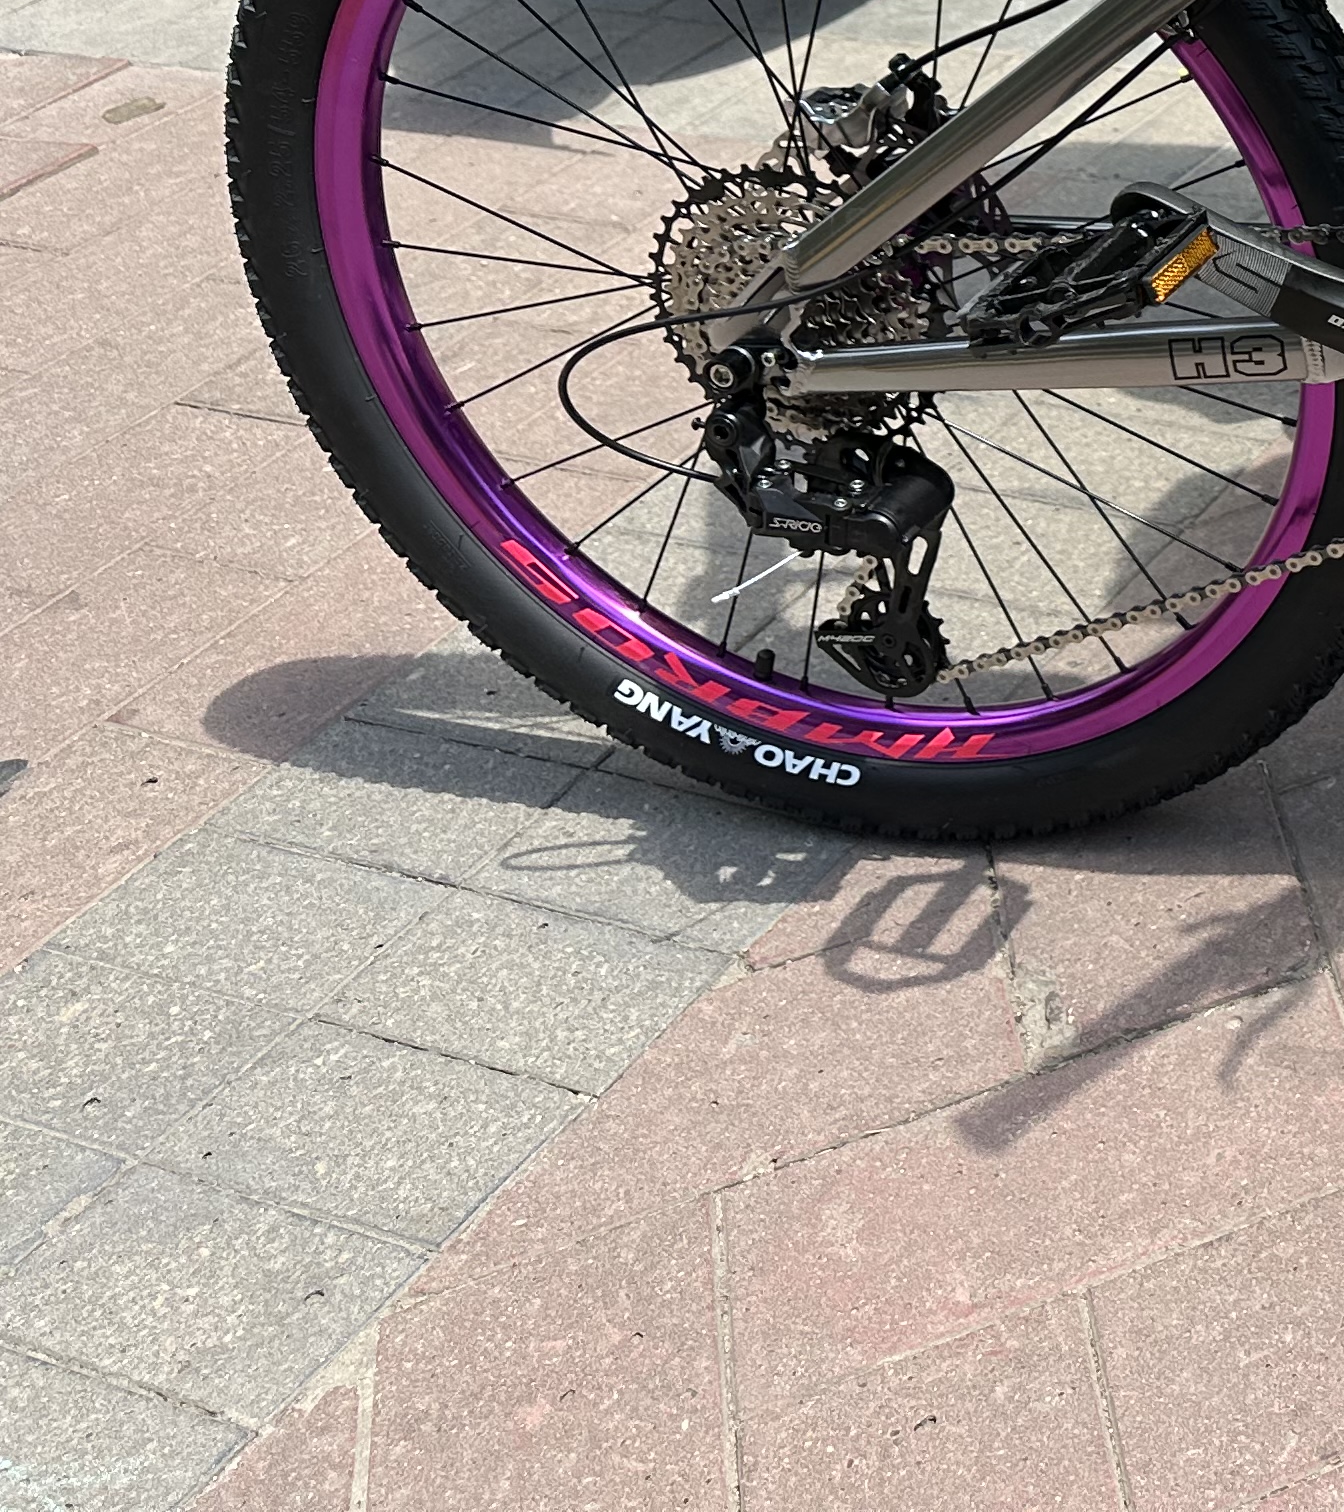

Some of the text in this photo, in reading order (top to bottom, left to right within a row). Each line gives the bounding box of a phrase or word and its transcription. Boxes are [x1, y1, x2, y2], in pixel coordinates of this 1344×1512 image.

[1168, 334, 1288, 381] H3
[498, 538, 1006, 762] HMBROS
[616, 678, 711, 741] YANG
[755, 743, 862, 788] CHAO
